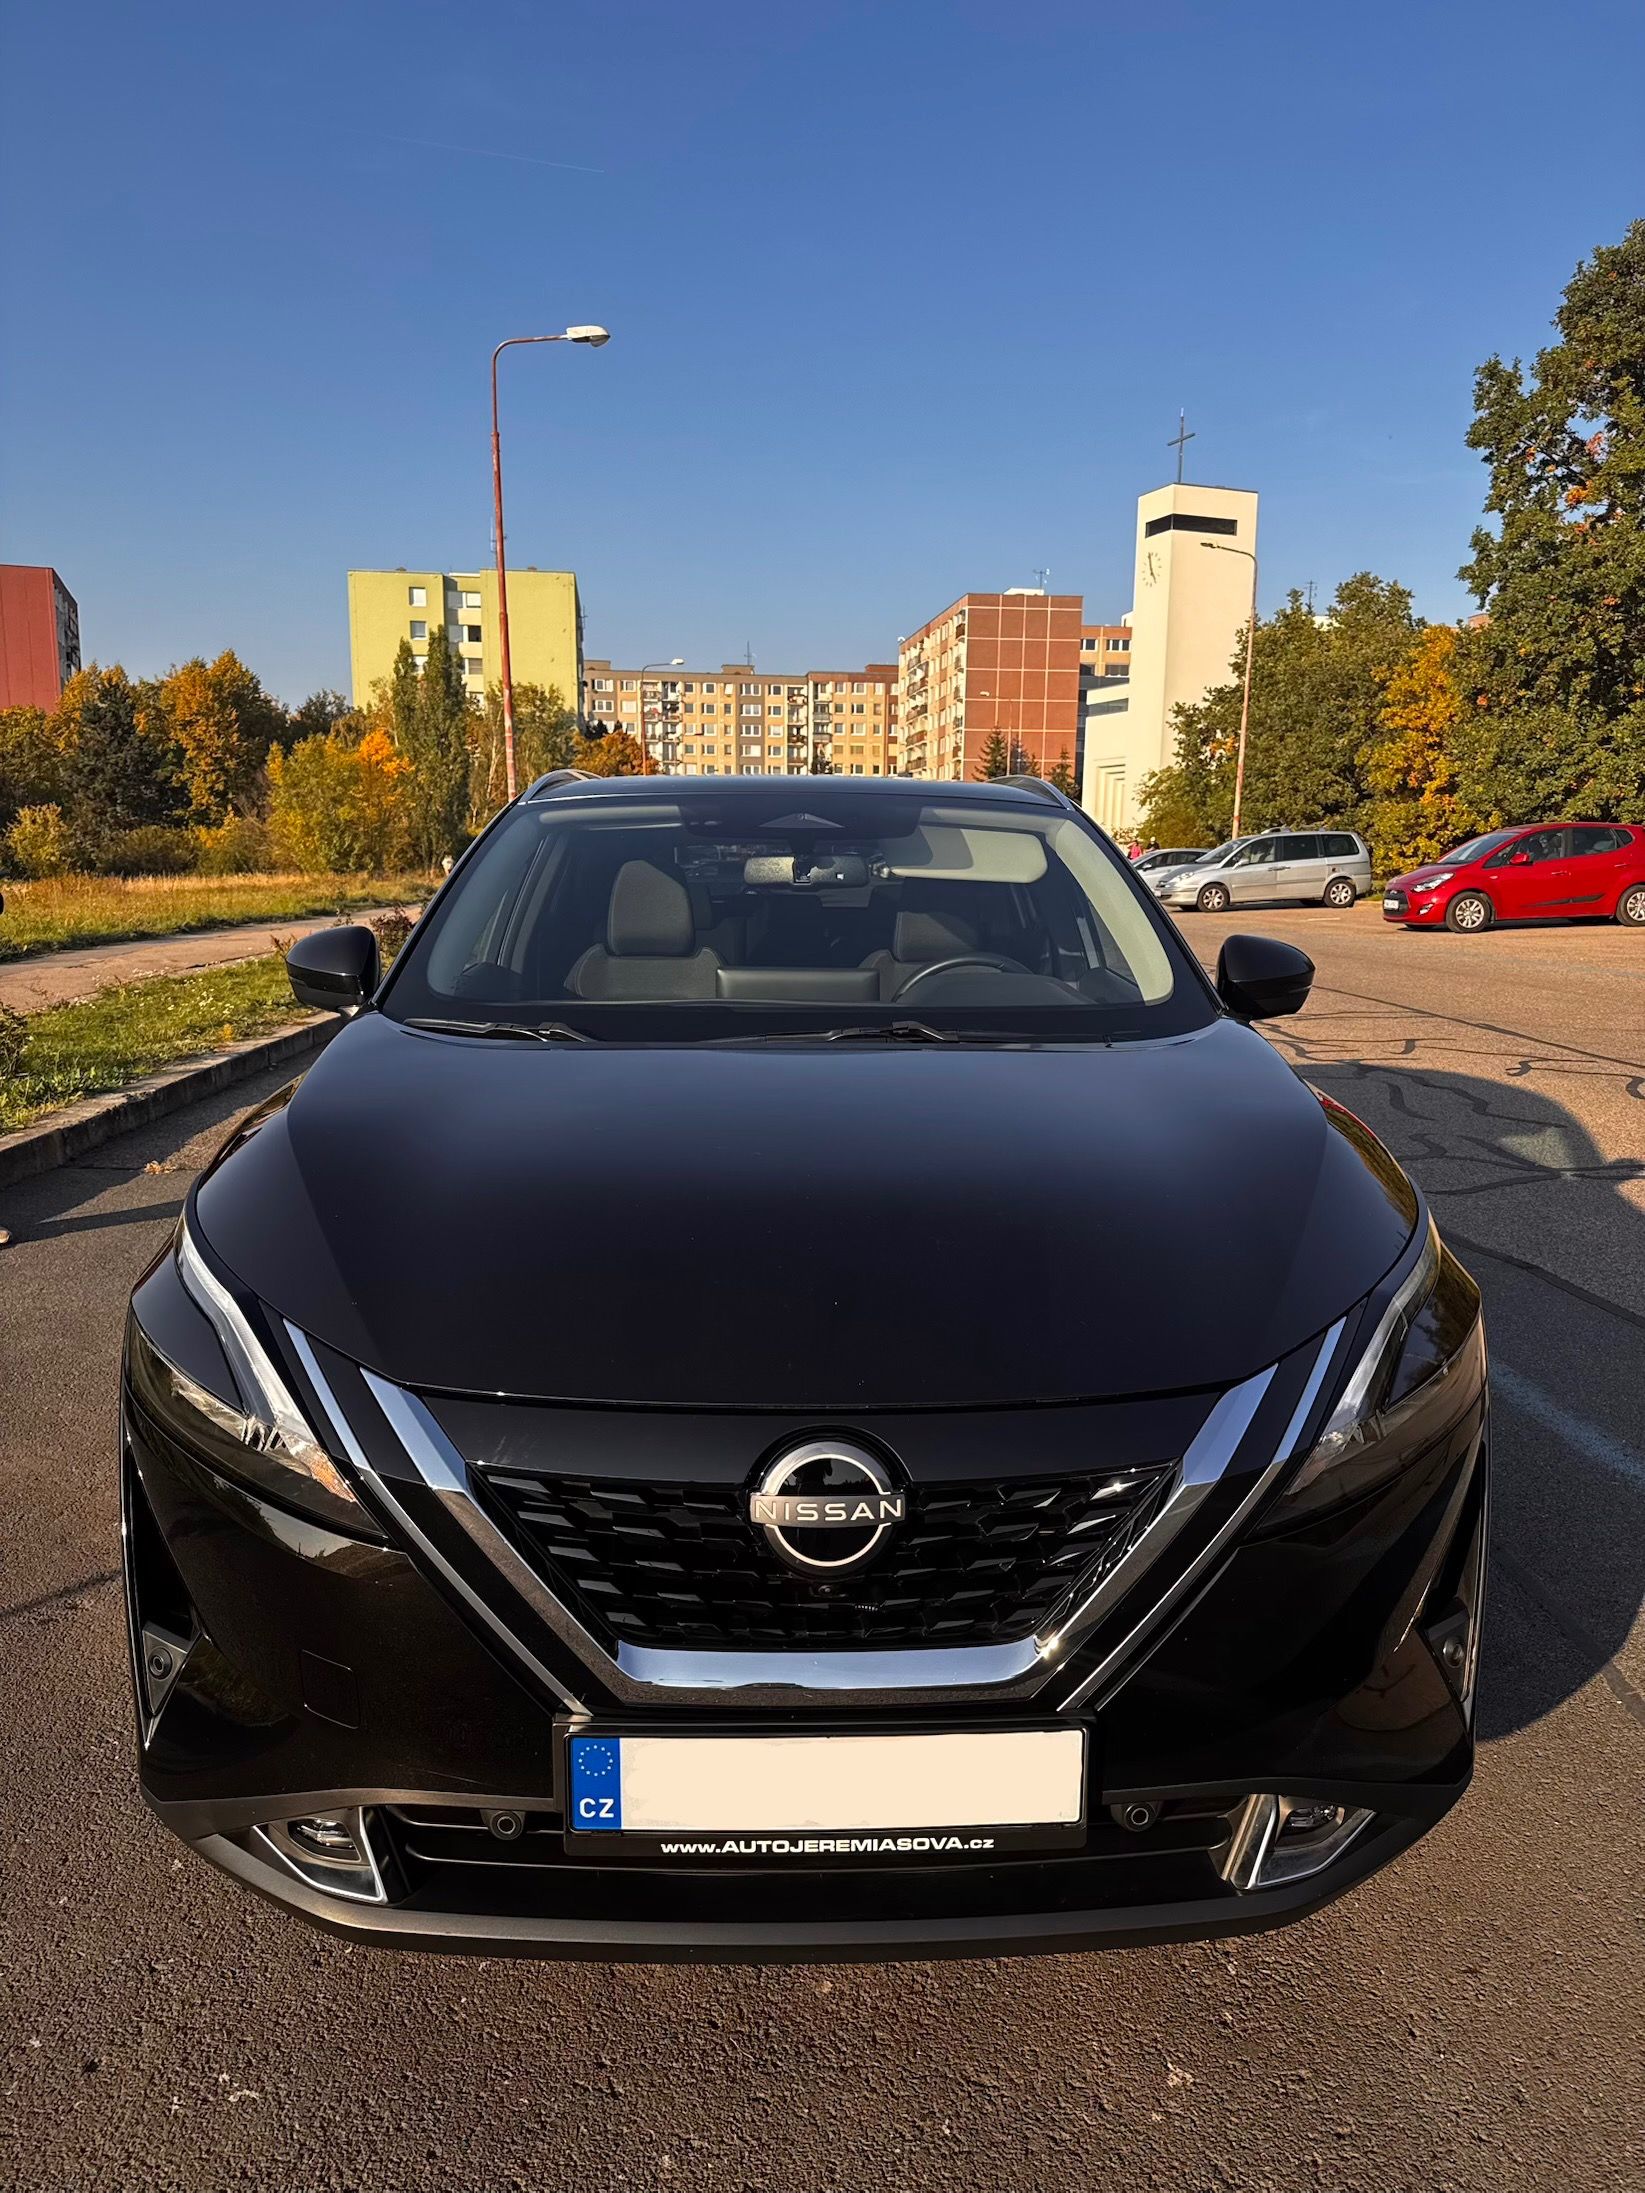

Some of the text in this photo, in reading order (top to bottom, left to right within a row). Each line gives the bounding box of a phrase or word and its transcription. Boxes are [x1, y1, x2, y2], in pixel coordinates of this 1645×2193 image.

[755, 1499, 902, 1521] NISSAN
[579, 1797, 614, 1818] CZ
[660, 1837, 995, 1853] www.AUTOJEREMIASOVA.cz
